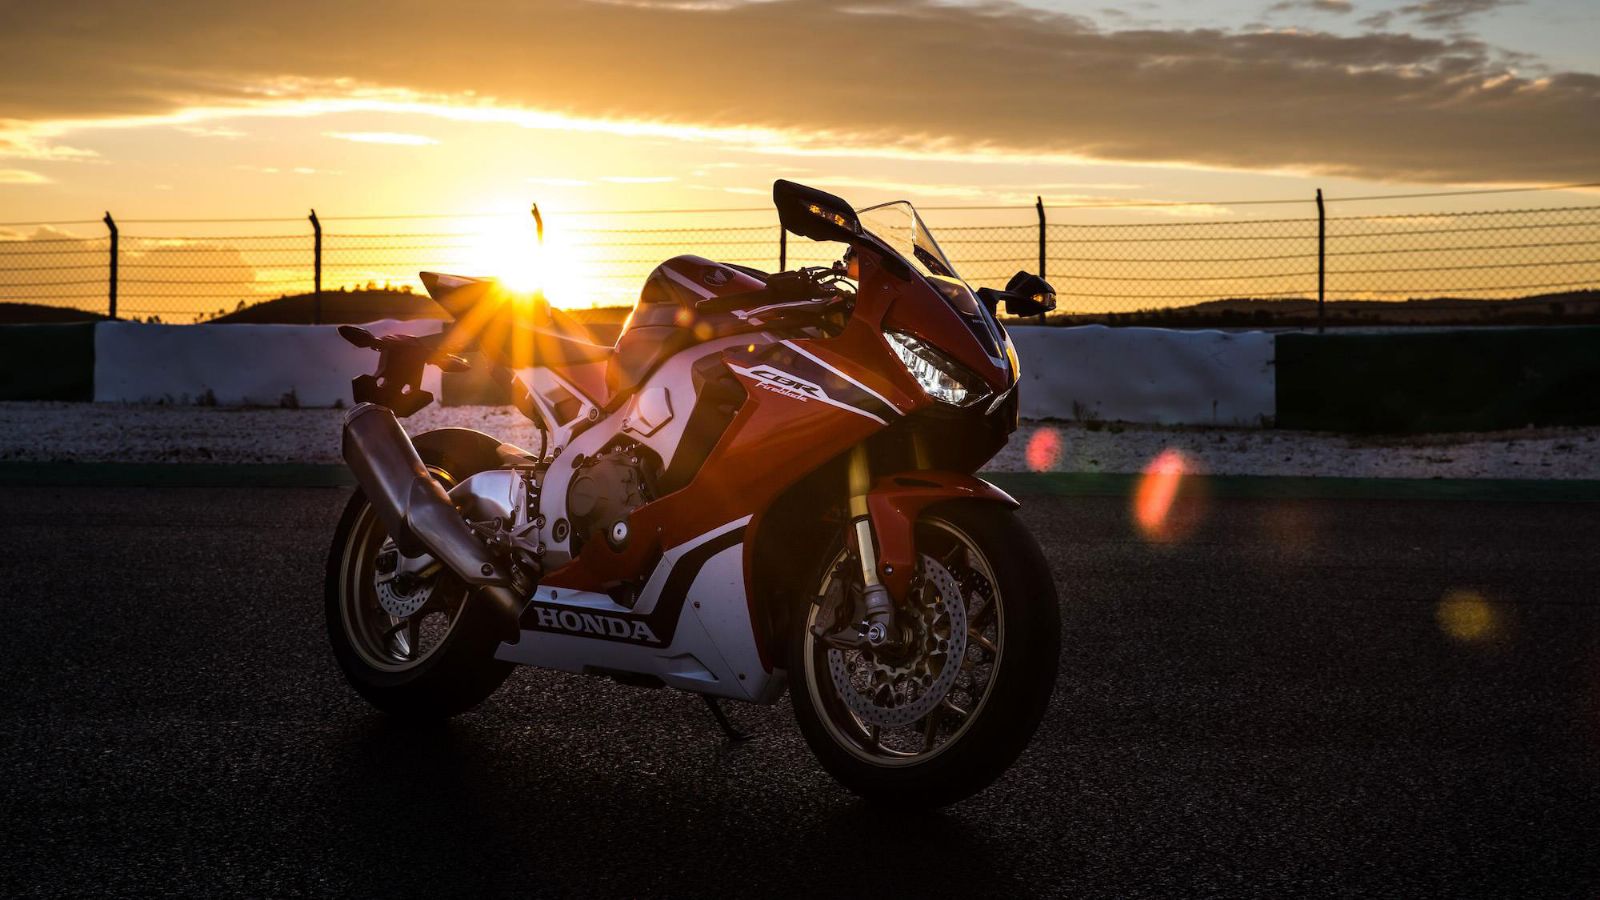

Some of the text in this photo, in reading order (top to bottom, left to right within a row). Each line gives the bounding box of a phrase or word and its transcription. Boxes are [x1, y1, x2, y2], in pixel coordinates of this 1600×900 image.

[751, 370, 819, 398] CBR
[755, 381, 808, 402] Fireblade
[534, 607, 661, 643] HONDA
